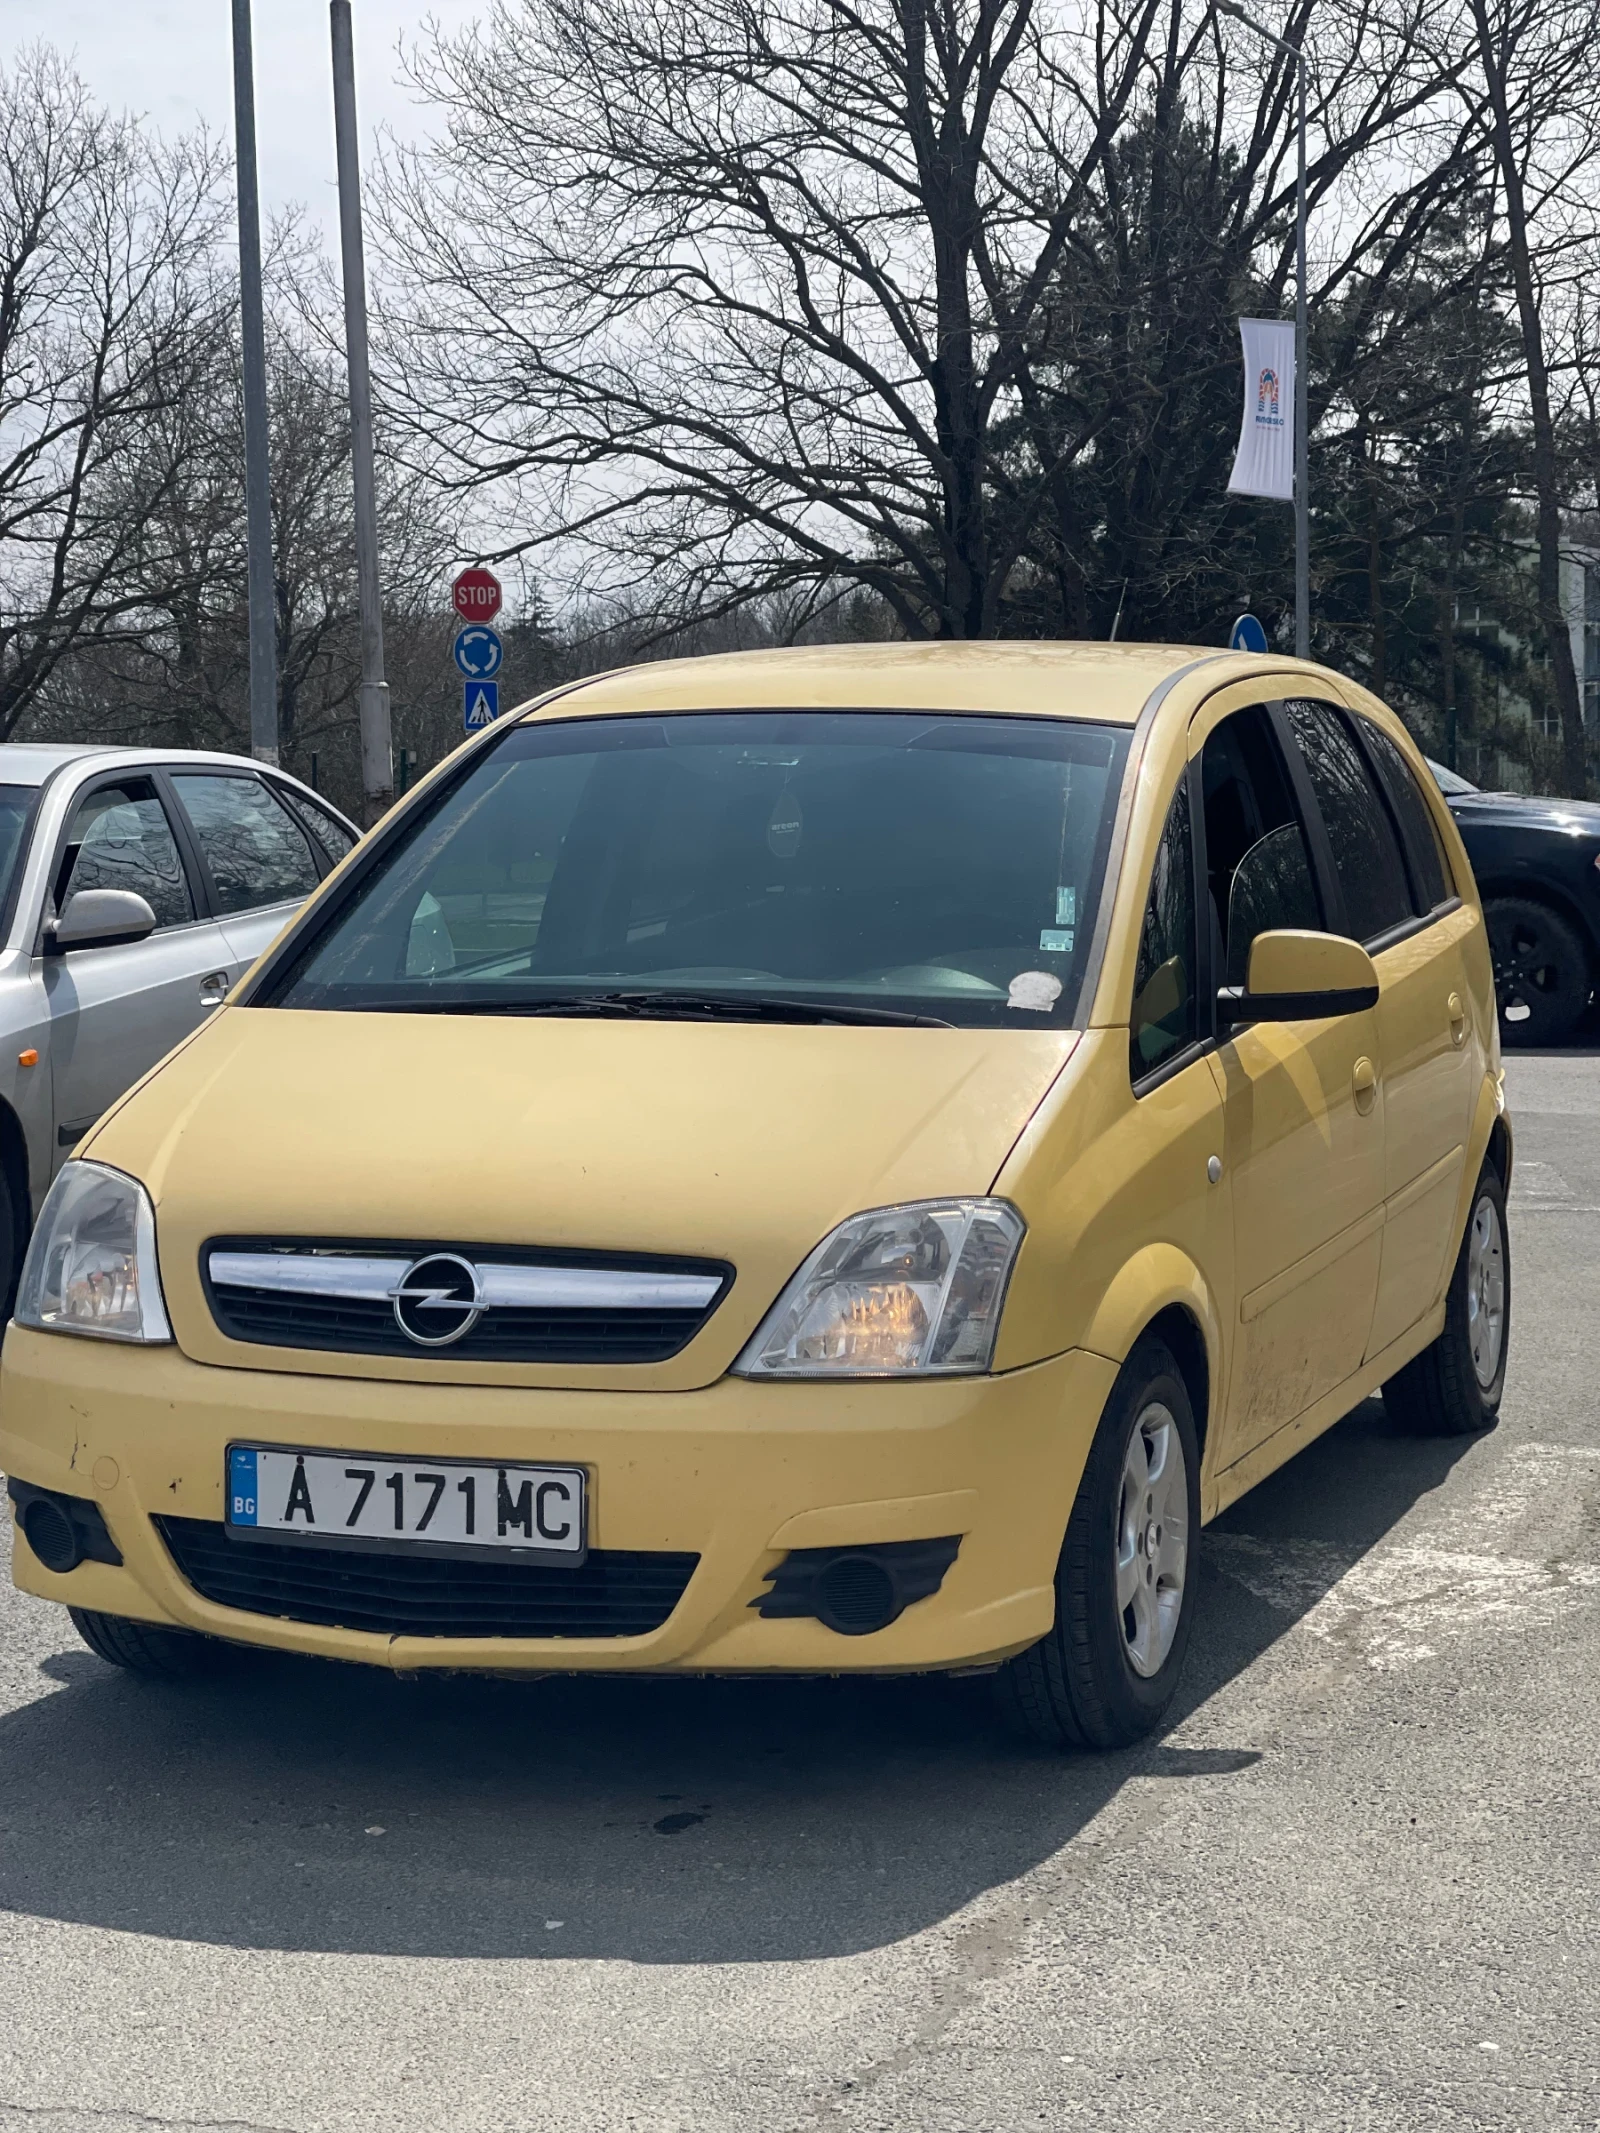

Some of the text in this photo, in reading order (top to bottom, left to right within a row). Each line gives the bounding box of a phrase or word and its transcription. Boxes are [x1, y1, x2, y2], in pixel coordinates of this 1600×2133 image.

[458, 586, 497, 605] STOP
[771, 821, 800, 831] areon
[233, 1496, 255, 1515] BG
[284, 1458, 571, 1541] A 7171 MC
